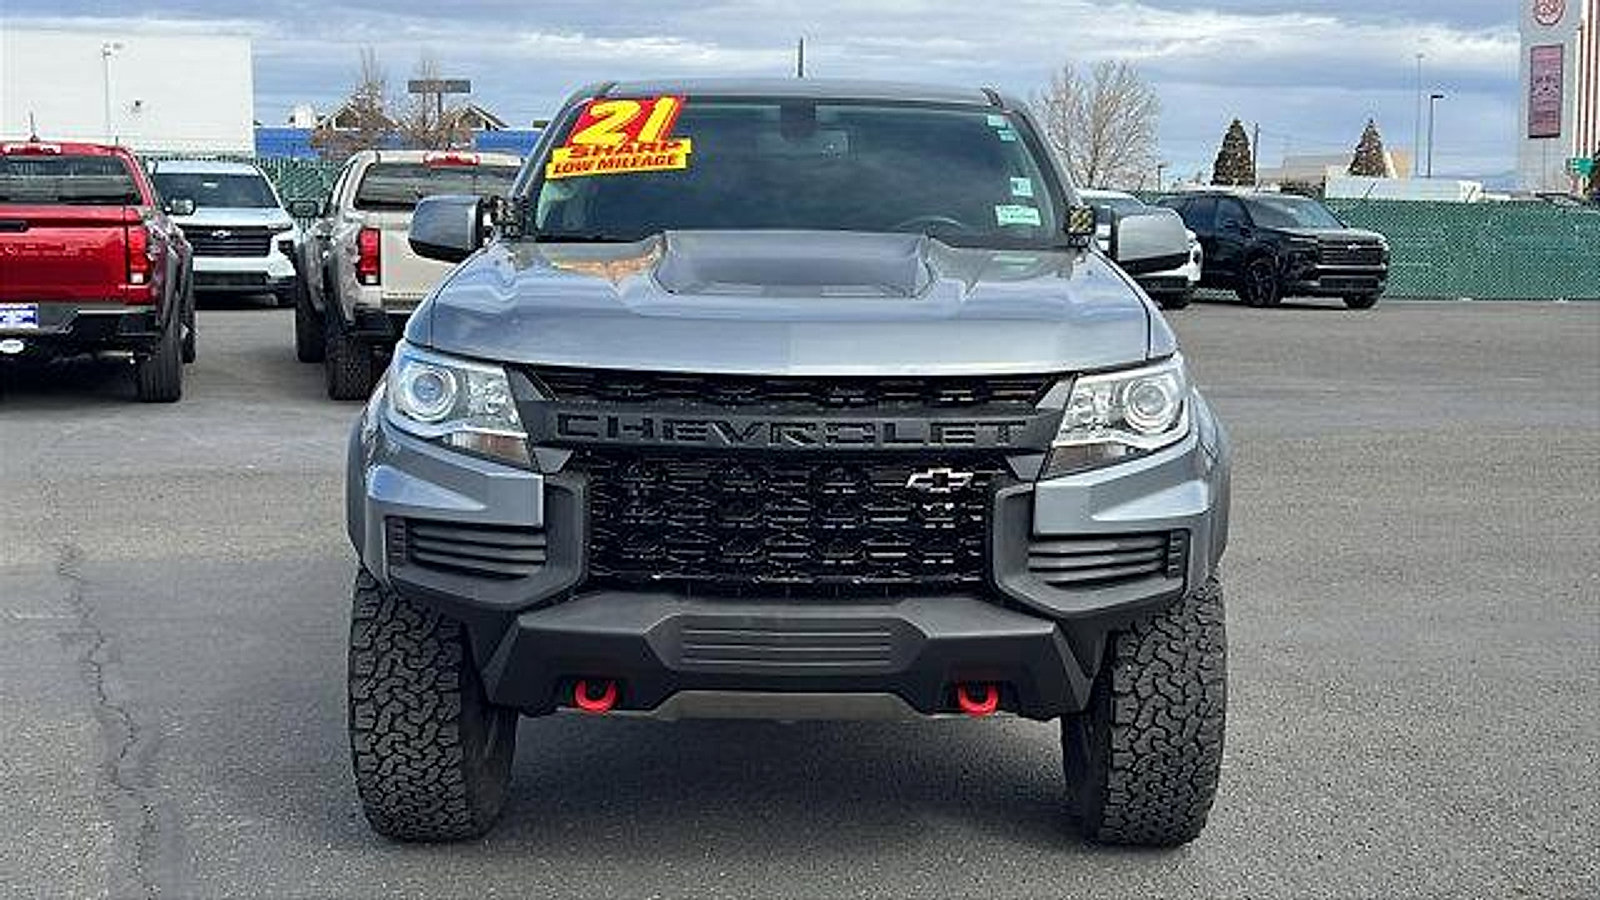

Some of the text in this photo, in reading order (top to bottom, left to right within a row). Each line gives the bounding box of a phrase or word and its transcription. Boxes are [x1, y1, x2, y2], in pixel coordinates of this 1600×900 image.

[572, 97, 678, 144] 21
[553, 154, 677, 174] LOW MILEAGE
[556, 413, 1026, 446] CHEVROLET
